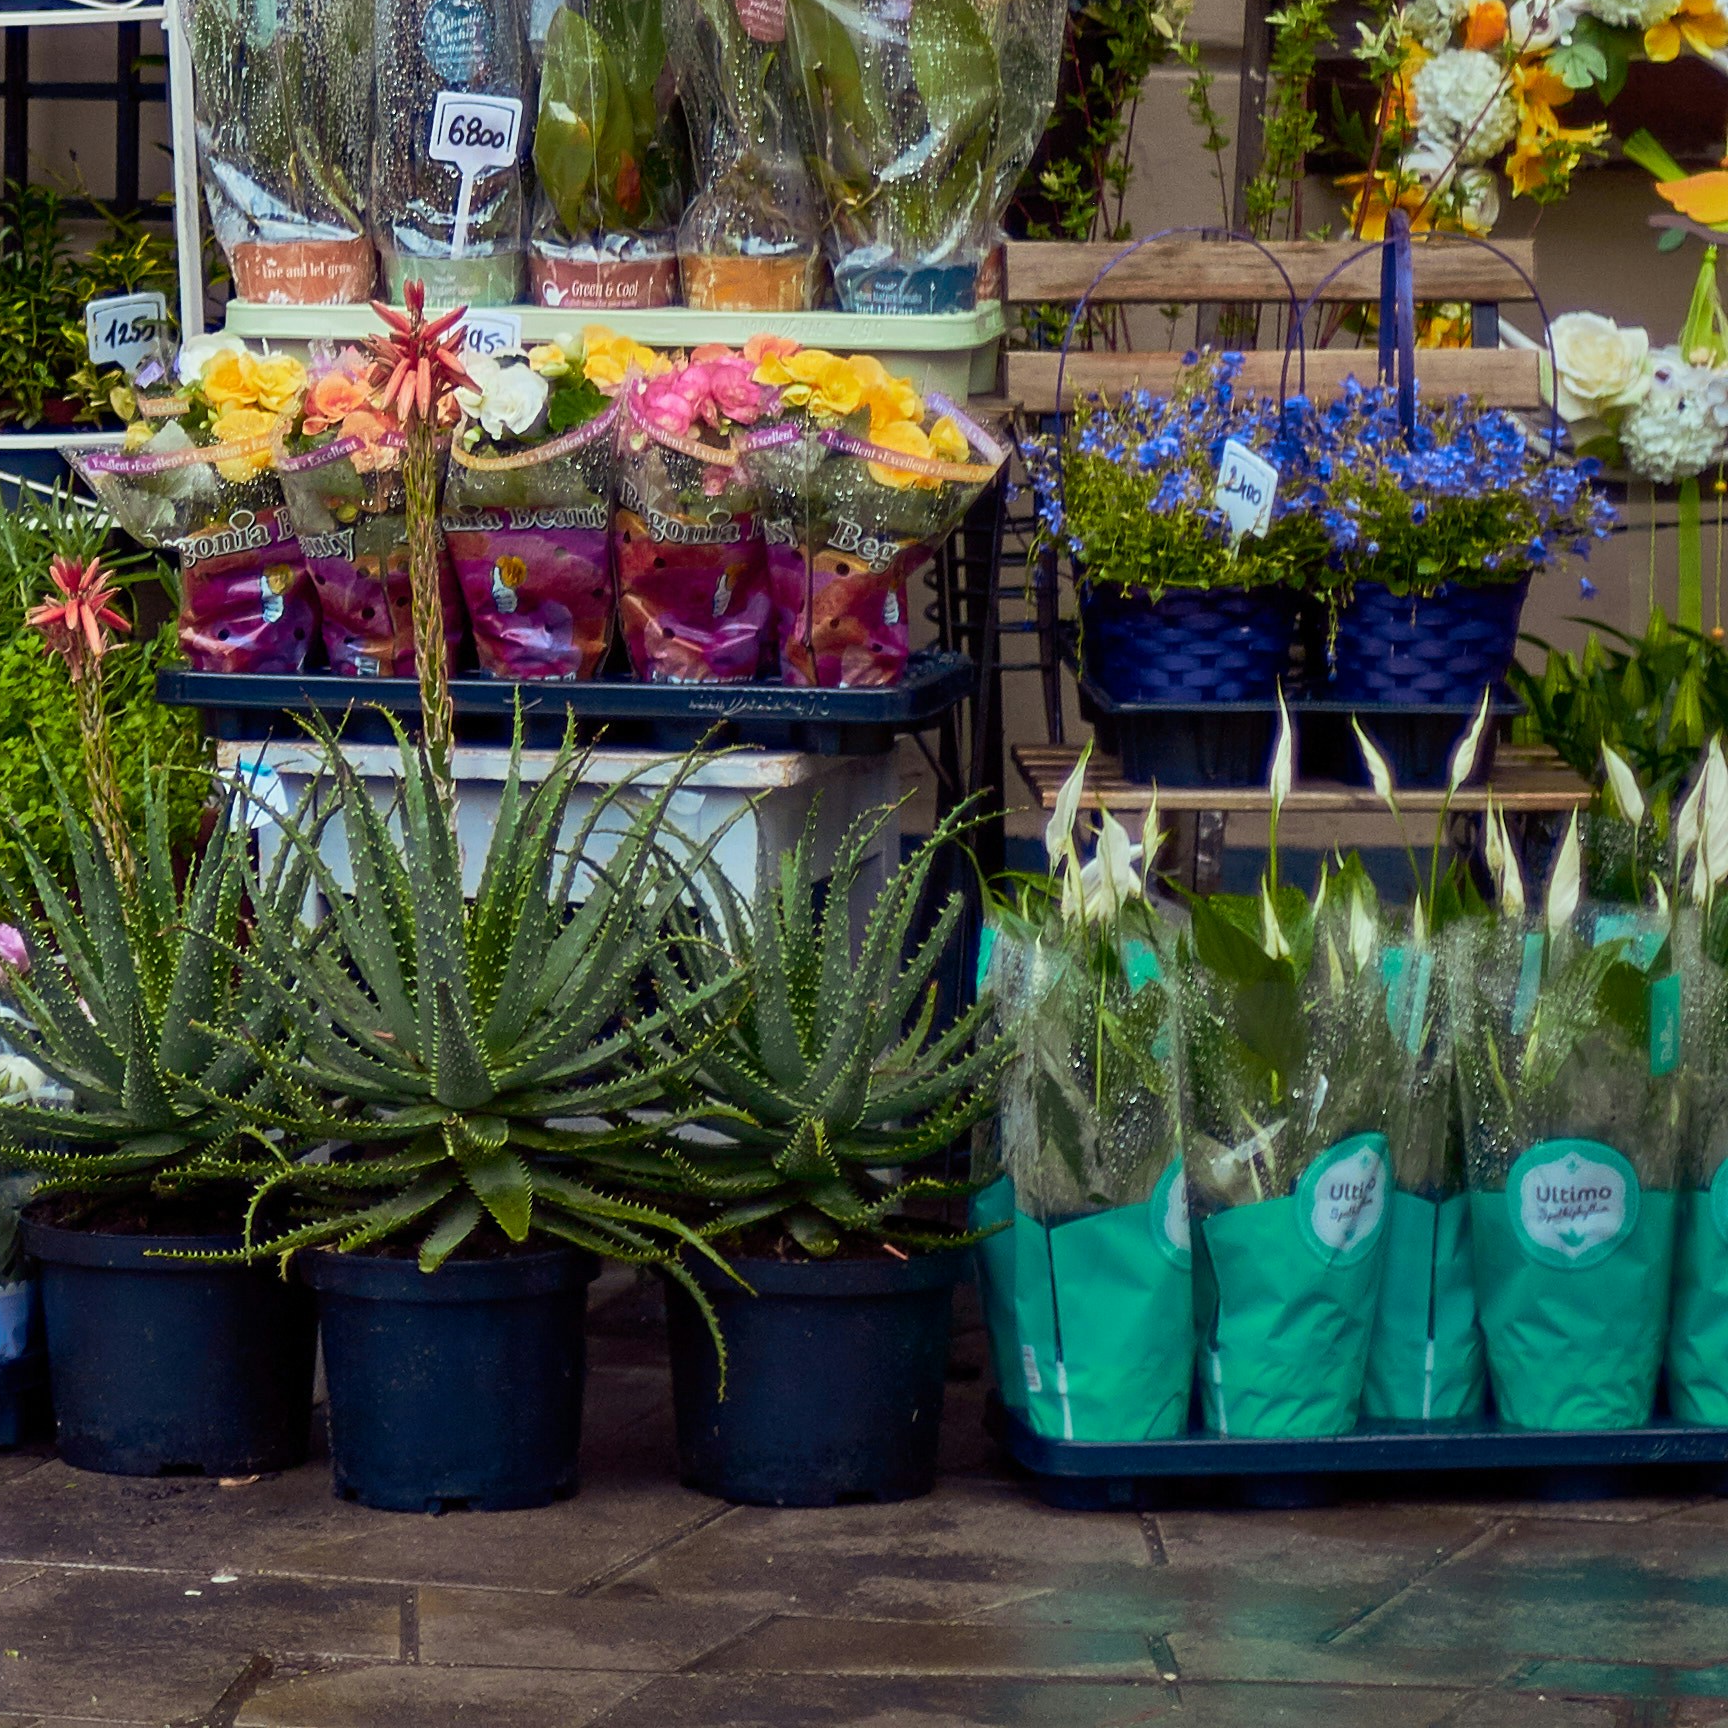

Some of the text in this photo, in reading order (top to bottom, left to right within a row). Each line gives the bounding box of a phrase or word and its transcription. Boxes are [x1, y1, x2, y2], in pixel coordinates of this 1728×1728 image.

[448, 114, 505, 149] 6800
[286, 262, 307, 278] and
[572, 281, 602, 297] Green
[617, 279, 640, 298] Cool
[307, 440, 358, 469] Excellent
[826, 430, 876, 459] Excellent
[825, 515, 901, 573] Beg
[1536, 1184, 1613, 1202] Ultimo
